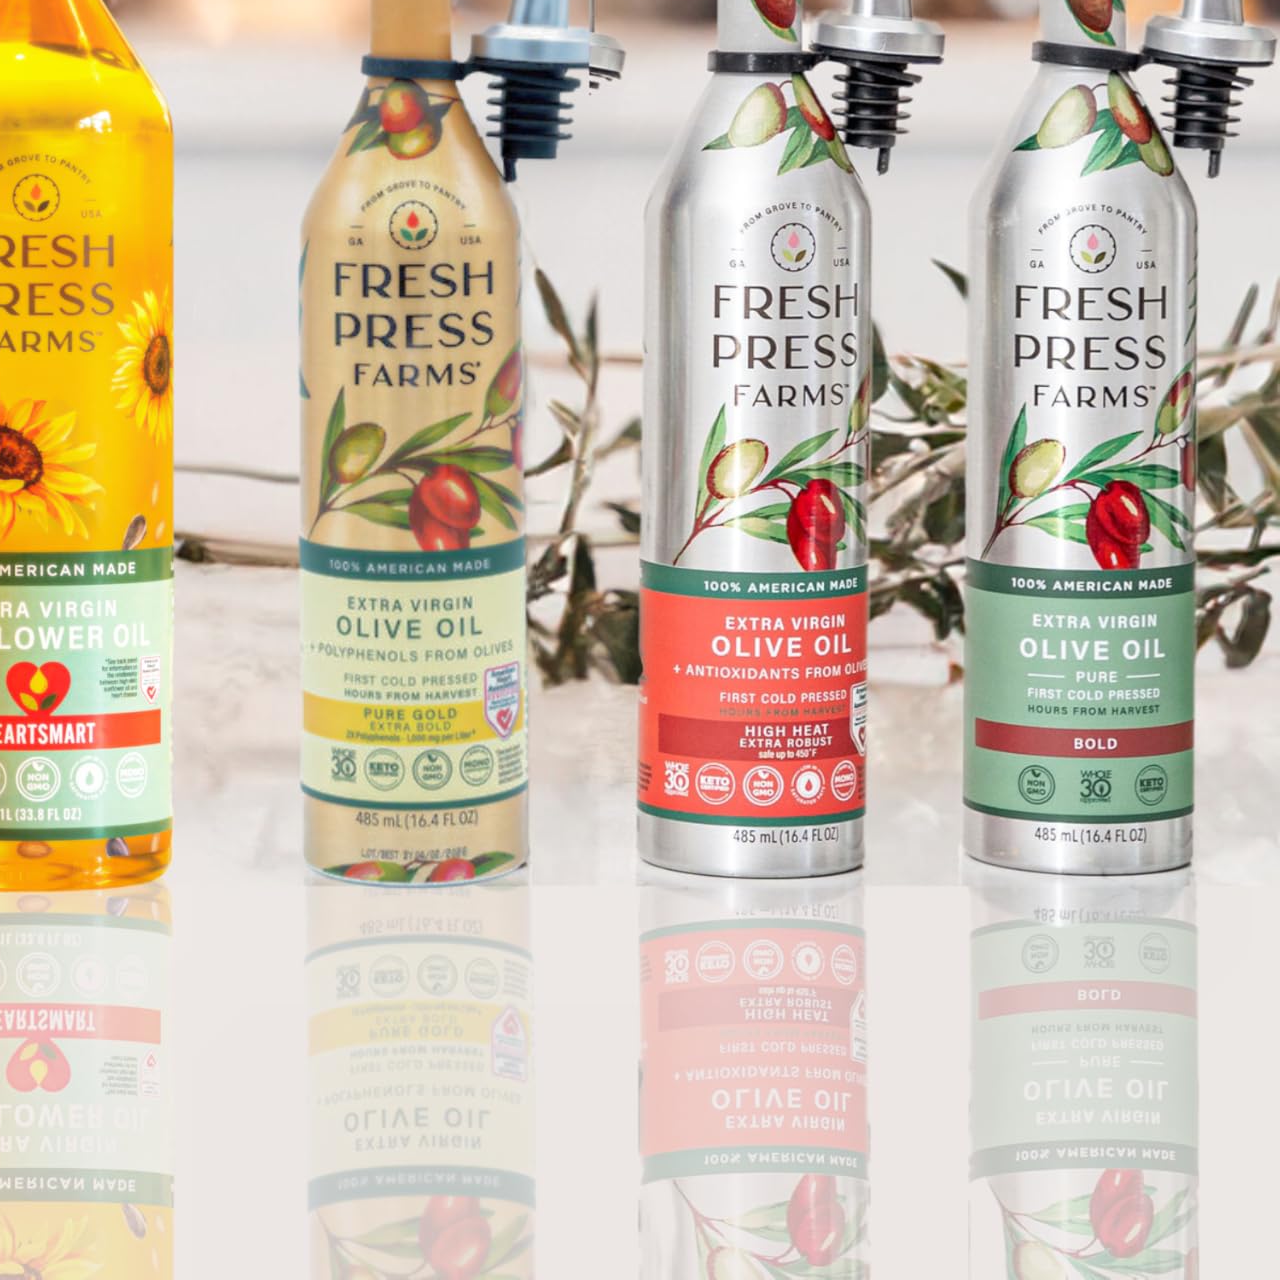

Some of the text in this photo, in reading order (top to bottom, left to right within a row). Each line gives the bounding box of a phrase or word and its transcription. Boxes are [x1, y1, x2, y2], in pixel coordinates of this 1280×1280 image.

[81, 210, 102, 218] USA
[1030, 260, 1044, 269] GA
[1137, 261, 1156, 269] USA
[335, 261, 494, 299] FRESH
[714, 283, 858, 320] FRESH
[1015, 285, 1167, 321] FRESH
[335, 310, 494, 349] PRESS
[713, 332, 857, 369] PRESS
[1014, 334, 1166, 371] PRESS
[92, 562, 136, 575] MADE
[704, 578, 858, 593] 100% AMERICAN MADE
[1011, 577, 1173, 592] 100% AMERICAN MADE
[40, 600, 117, 618] VIRGIN
[347, 596, 474, 612] EXTRA VIRGIN
[336, 615, 482, 639] OLIVE OIL
[725, 615, 845, 631] EXTRA VIRGIN
[1033, 614, 1157, 629] EXTRA VIRGIN
[113, 624, 150, 647] OIL
[318, 643, 418, 662] POLYPHENOLS
[425, 649, 468, 661] FROM
[474, 640, 513, 658] OLIVES
[711, 634, 852, 658] OLIVE OIL
[1020, 637, 1165, 661] OLIVE OIL
[685, 664, 799, 680] ANTIOXIDANTS
[806, 665, 841, 678] FROM
[1076, 672, 1118, 683] PURE
[720, 689, 847, 704] FIRST COLD PRESSED
[1028, 688, 1160, 701] FIRST COLD PRESSED
[363, 708, 457, 720] PURE GOLD
[1028, 704, 1160, 715] HOURS FROM HARVEST
[745, 723, 829, 737] HIGH HEAT
[739, 736, 833, 748] EXTRA ROBUST
[1074, 738, 1118, 750] BOLD
[1080, 770, 1112, 780] WHOLE
[1139, 778, 1164, 786] KETO
[1080, 779, 1112, 798] 30
[0, 808, 82, 822] 1L (33.8 FL OZ)
[1034, 827, 1056, 841] 485
[1115, 829, 1127, 842] FL
